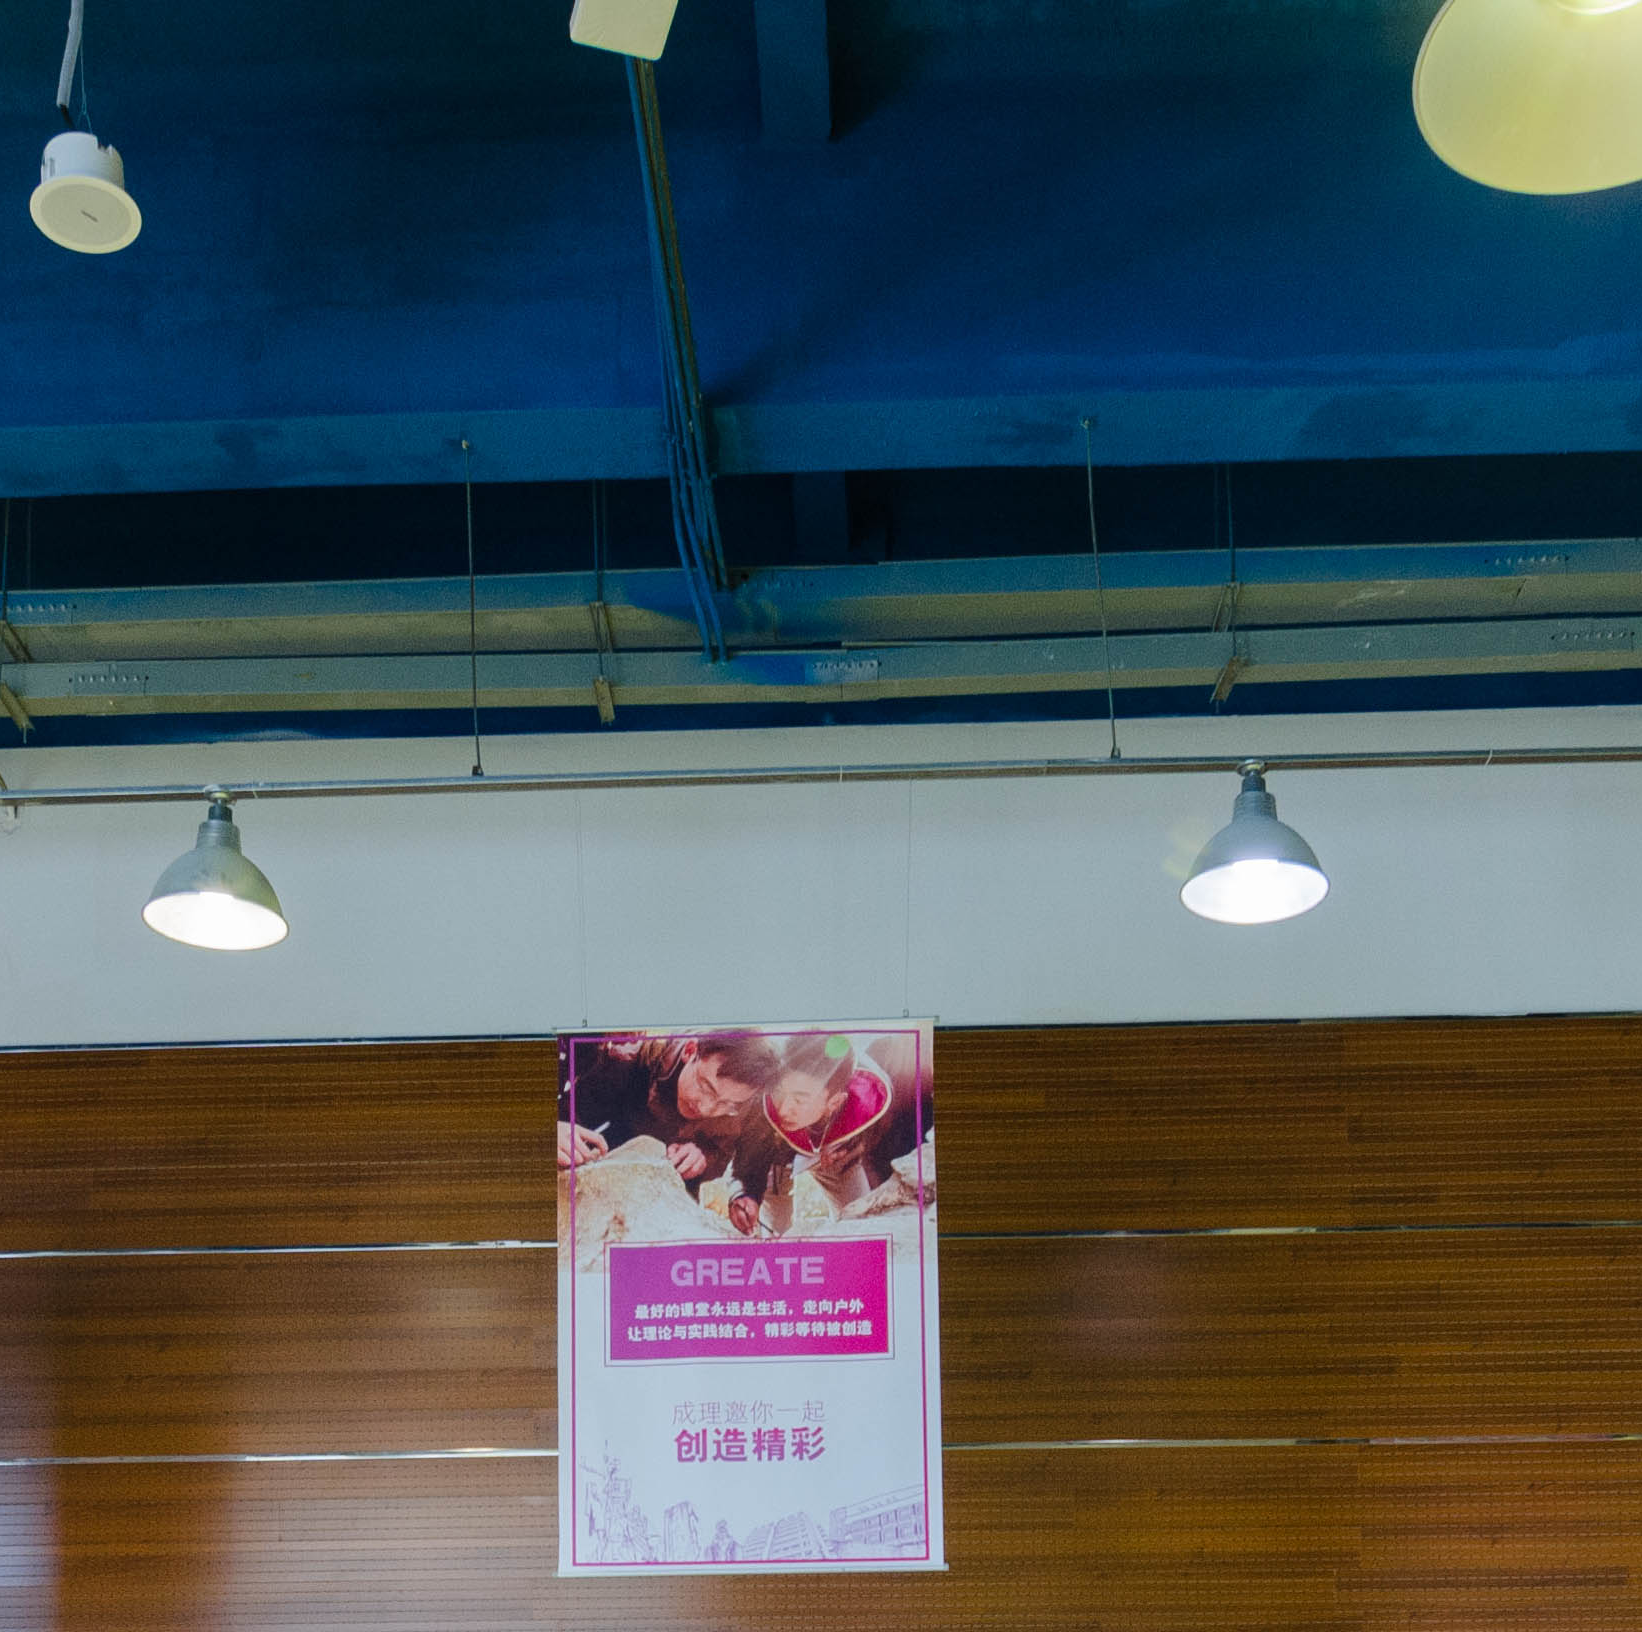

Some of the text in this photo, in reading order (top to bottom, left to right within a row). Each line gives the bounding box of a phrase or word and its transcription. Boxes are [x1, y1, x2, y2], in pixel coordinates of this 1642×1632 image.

[670, 1255, 826, 1287] GREATE
[672, 1399, 827, 1425] 成理邀你一起
[674, 1426, 827, 1463] 创造精彩
